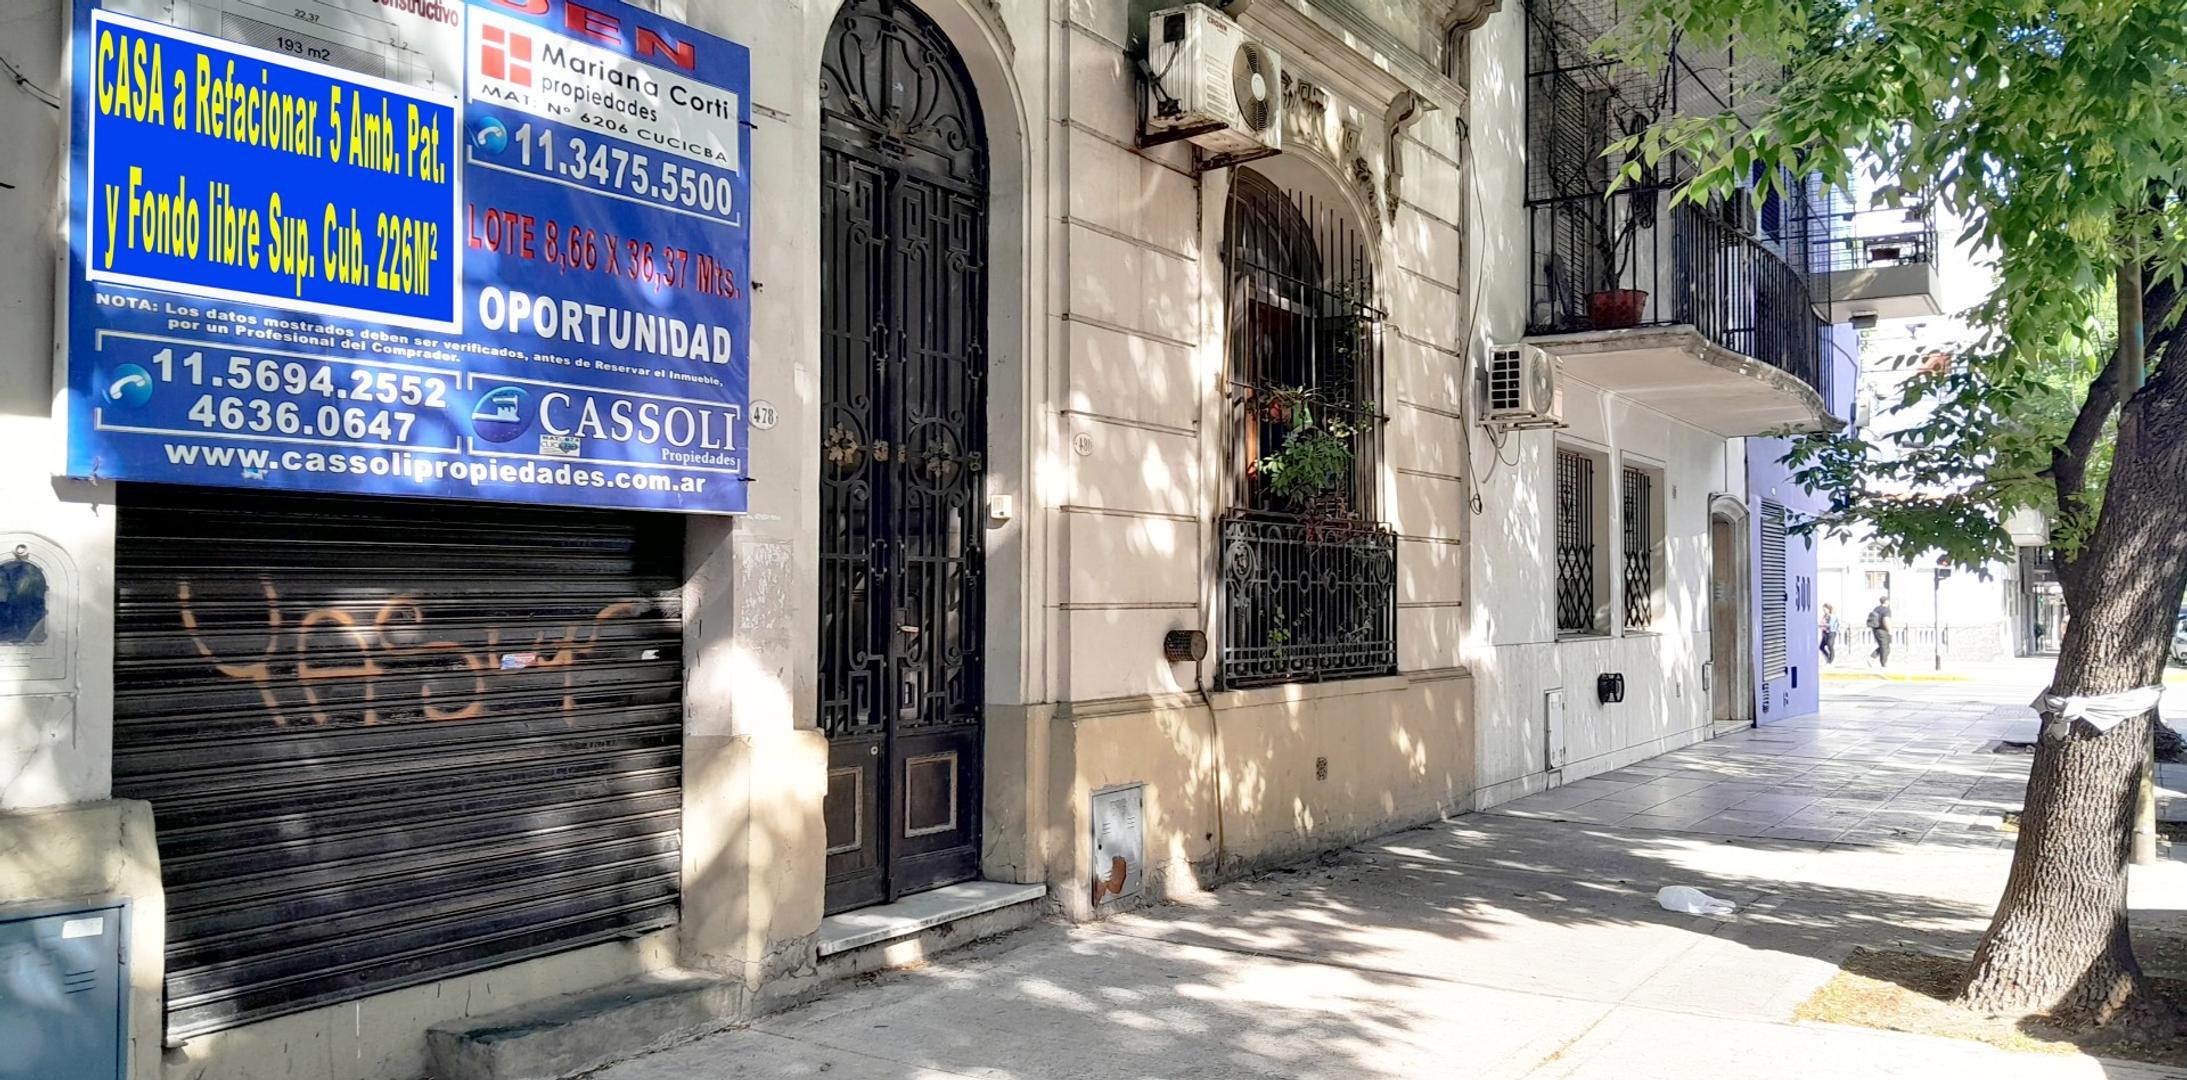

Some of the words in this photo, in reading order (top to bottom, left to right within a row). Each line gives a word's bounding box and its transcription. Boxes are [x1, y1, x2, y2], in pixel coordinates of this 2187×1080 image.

[277, 36, 303, 54] 193
[307, 47, 331, 61] m2
[491, 0, 695, 71] EN
[98, 29, 165, 126] CASA
[173, 68, 186, 130] a
[196, 53, 322, 158] Refacionar.
[330, 85, 341, 162] 5
[348, 90, 400, 174] Amb.
[407, 103, 445, 184] Pat.
[542, 44, 659, 98] Mariana
[670, 86, 729, 119] Corti
[542, 75, 658, 122] propiedades
[580, 113, 629, 134] 6206
[637, 129, 727, 163] CUCICBA
[515, 123, 733, 216] 11.3475.5500
[105, 183, 120, 269] y
[128, 165, 199, 260] Fondo
[209, 180, 260, 269] libre
[268, 192, 315, 297] Sup.
[323, 202, 369, 286] Cub.
[467, 203, 535, 259] LOTE
[545, 220, 598, 276] 8,66
[603, 232, 620, 276] X
[627, 239, 688, 293] 36,37
[696, 254, 741, 299] Mts.
[96, 293, 159, 311] NOTA:
[165, 302, 199, 317] Los
[206, 309, 257, 324] datos
[264, 317, 355, 337] mostrados
[360, 329, 408, 344] deben
[414, 337, 438, 348] ser
[444, 341, 529, 361] verificados,
[534, 353, 571, 366] antes
[575, 358, 591, 368] de
[595, 360, 650, 376] Reservar
[654, 369, 665, 378] el
[669, 371, 723, 387] Inmueble,
[168, 319, 200, 330] por
[206, 324, 228, 334] un
[235, 325, 335, 347] Profesional
[341, 338, 366, 350] del
[371, 341, 461, 362] Comprador.
[479, 286, 731, 365] OPORTUNIDAD
[152, 348, 448, 408] 11.5694.2552
[188, 394, 416, 442] 4636.0647
[540, 392, 737, 451] CASSOLI
[753, 406, 774, 425] 478
[164, 443, 707, 493] www.cassolipropiedades.com.ar
[661, 447, 736, 467] Propiedades
[1795, 575, 1812, 613] 500
